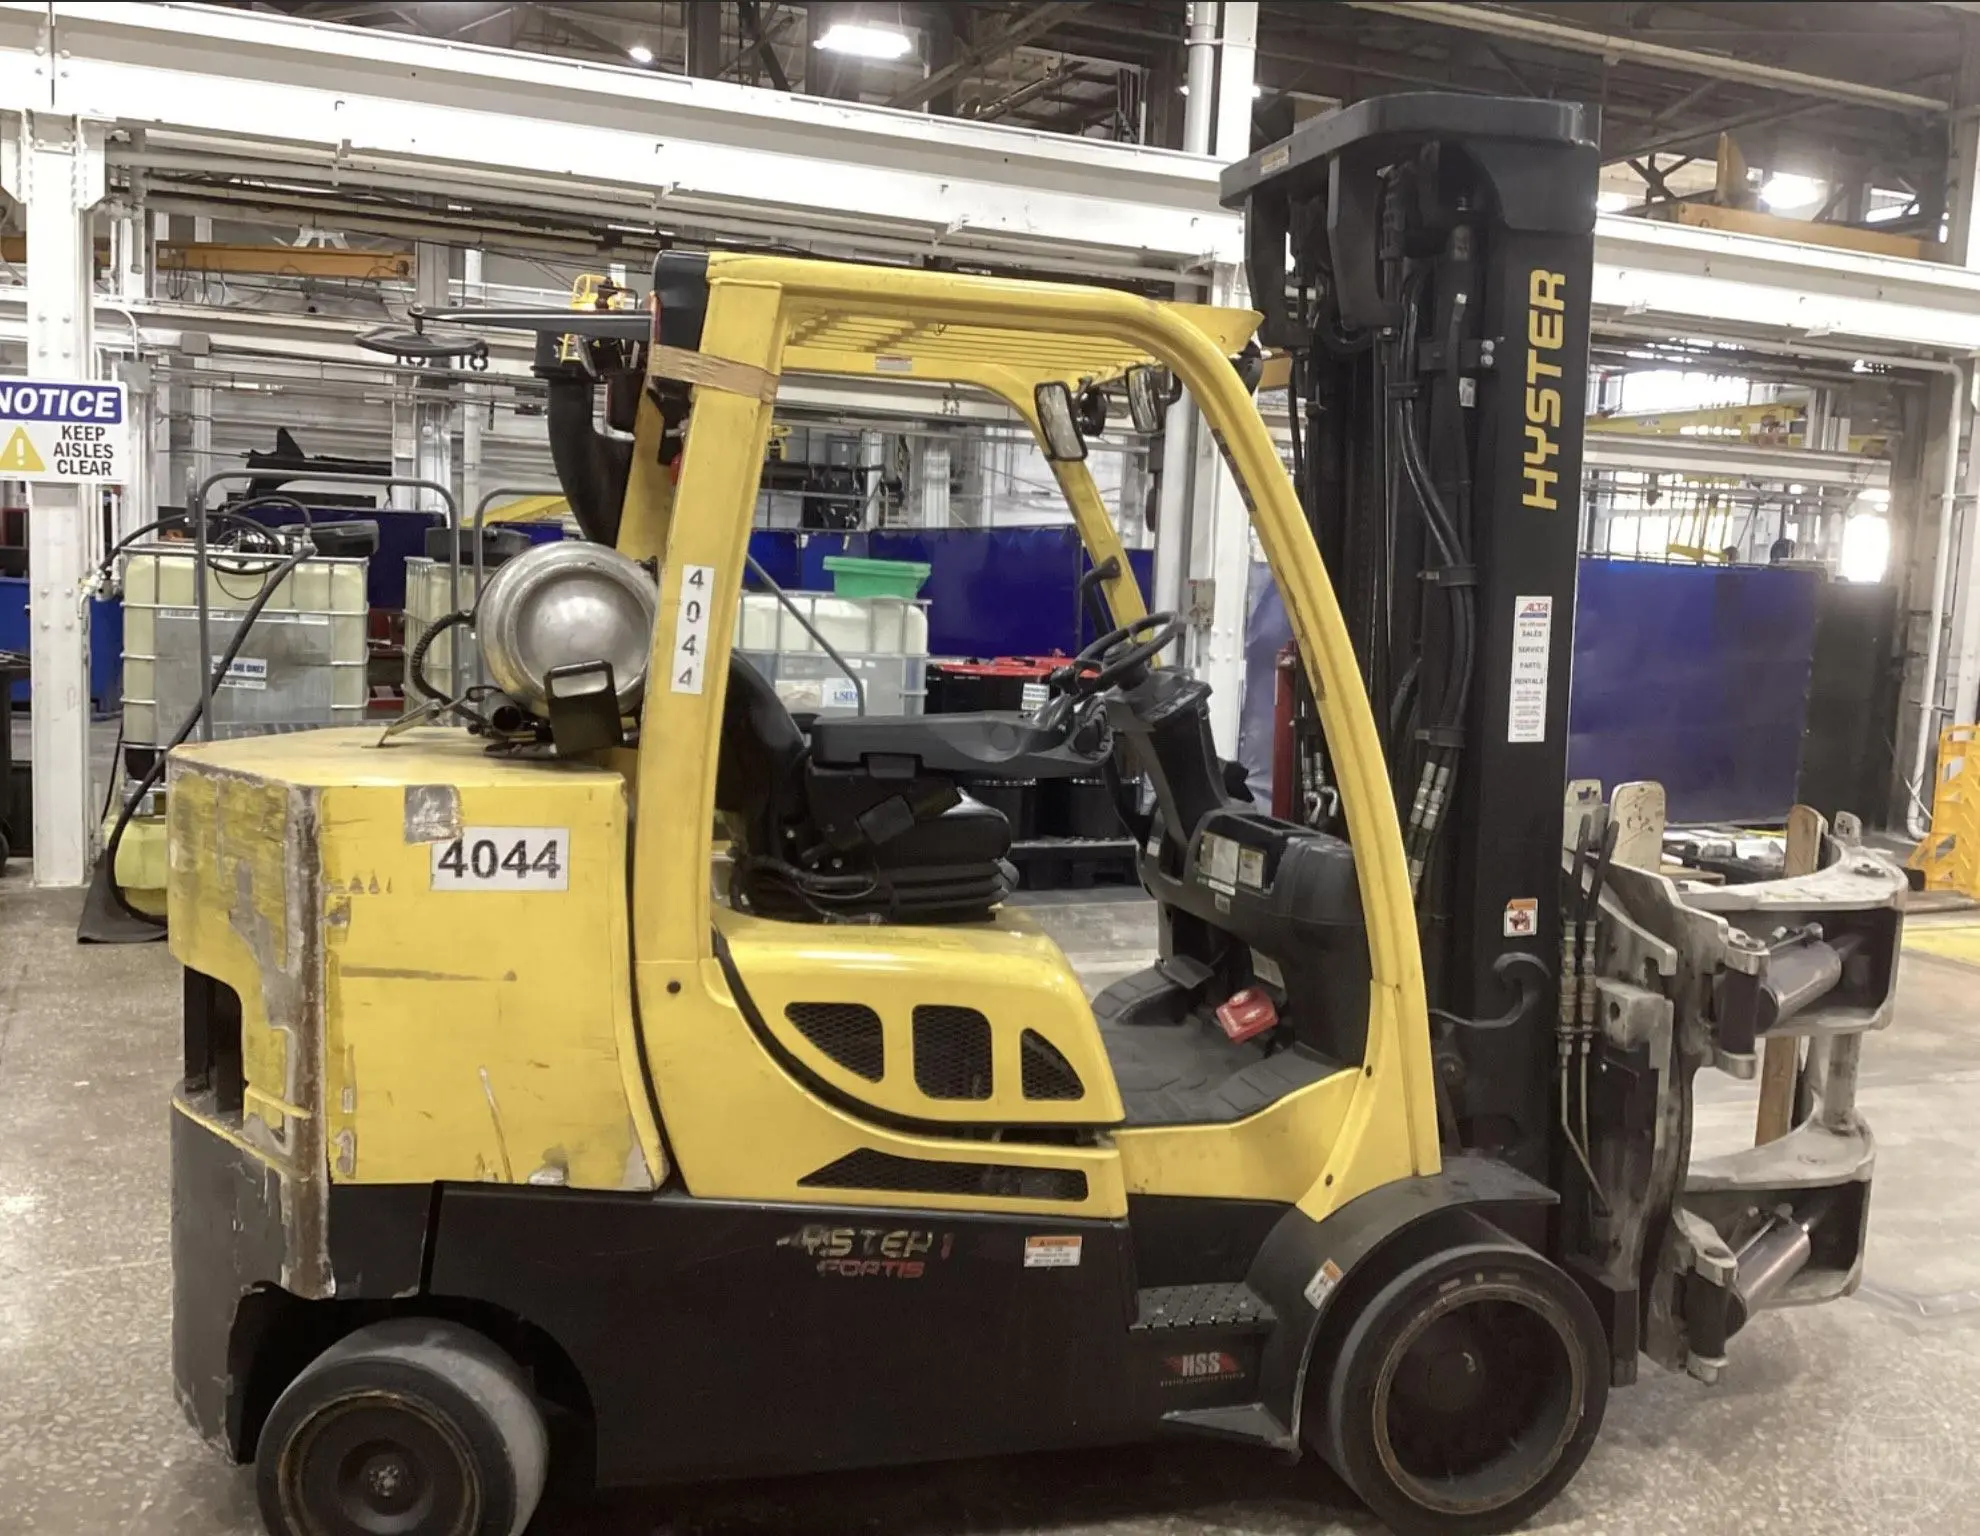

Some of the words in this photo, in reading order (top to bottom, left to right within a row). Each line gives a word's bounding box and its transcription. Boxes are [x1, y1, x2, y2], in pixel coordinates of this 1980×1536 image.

[1522, 269, 1566, 511] HYSTER
[61, 425, 105, 441] KEEP
[53, 442, 114, 459] AISLES
[57, 459, 112, 476] CLEAR
[438, 839, 561, 879] 4044
[1182, 1351, 1221, 1377] HSS
